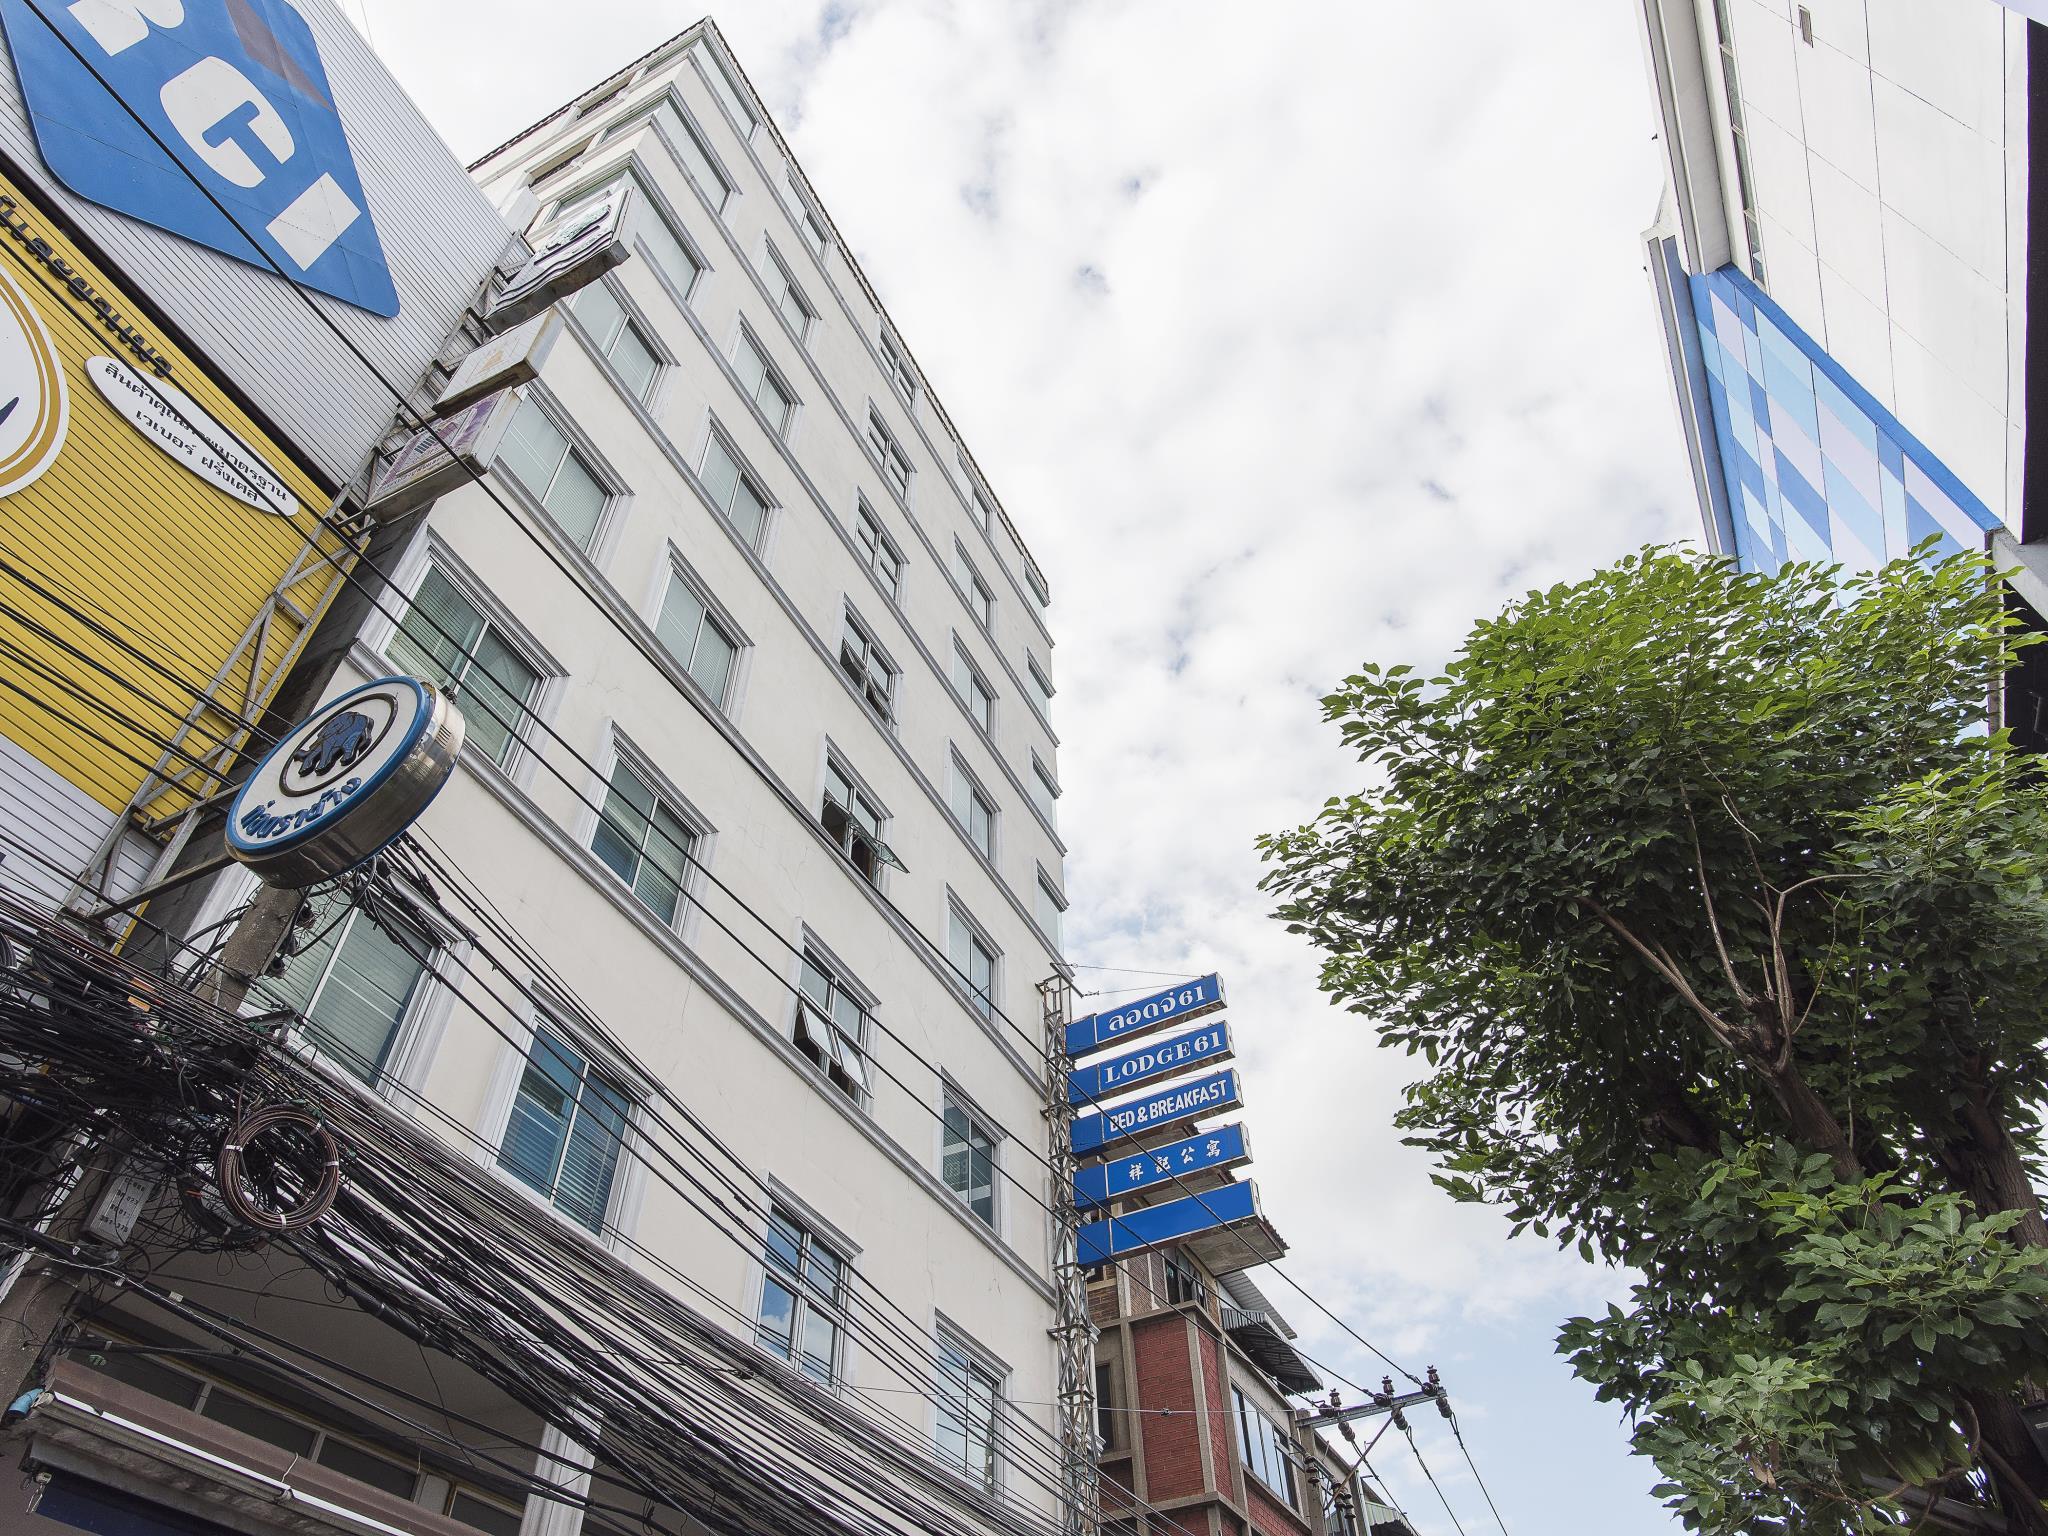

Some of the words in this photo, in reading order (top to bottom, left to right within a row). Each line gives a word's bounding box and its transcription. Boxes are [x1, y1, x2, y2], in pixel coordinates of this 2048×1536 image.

[136, 410, 196, 456] เวเบอร์
[1149, 1079, 1227, 1120] BREAKFAST
